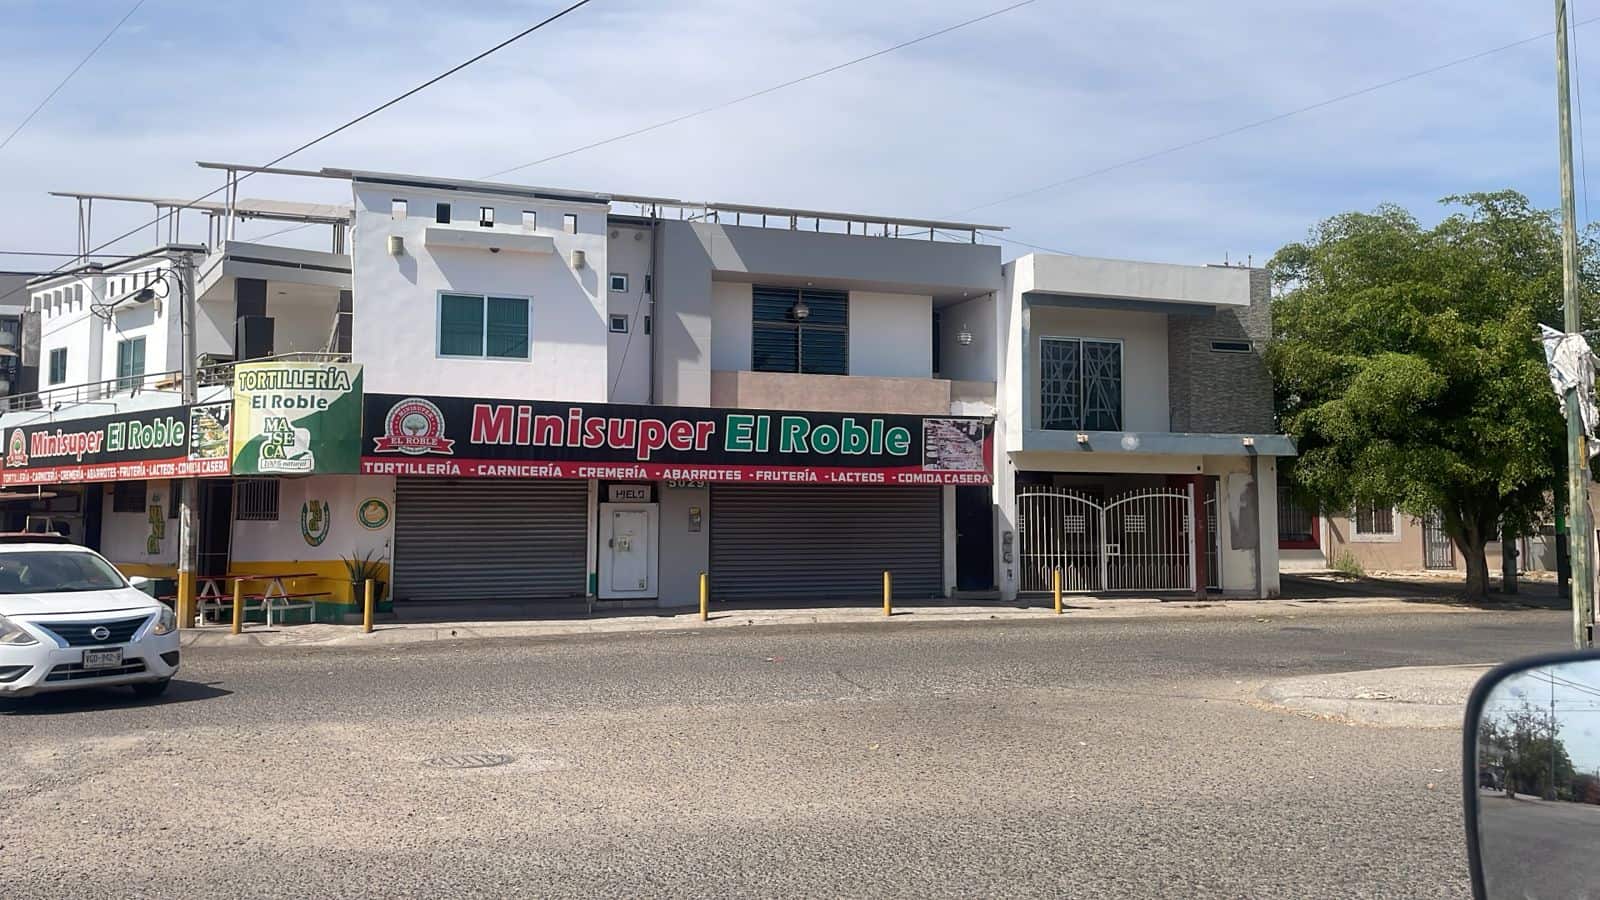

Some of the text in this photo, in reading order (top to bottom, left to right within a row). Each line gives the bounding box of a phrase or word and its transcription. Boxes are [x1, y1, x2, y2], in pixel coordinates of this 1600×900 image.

[239, 366, 351, 391] TORTILLERÍA
[252, 394, 328, 409] El Roble
[399, 405, 434, 419] MINISUPER
[264, 417, 291, 433] MA
[470, 403, 911, 461] Minisuper El Roble
[31, 416, 185, 462] Minisuper El Roble
[272, 431, 295, 446] SE
[391, 437, 438, 446] EL ROBLE
[262, 443, 287, 459] CA
[202, 459, 228, 473] CASERA
[364, 461, 461, 476] TORTILLERÍA
[944, 474, 990, 483] CASERA
[616, 490, 645, 499] HIELO
